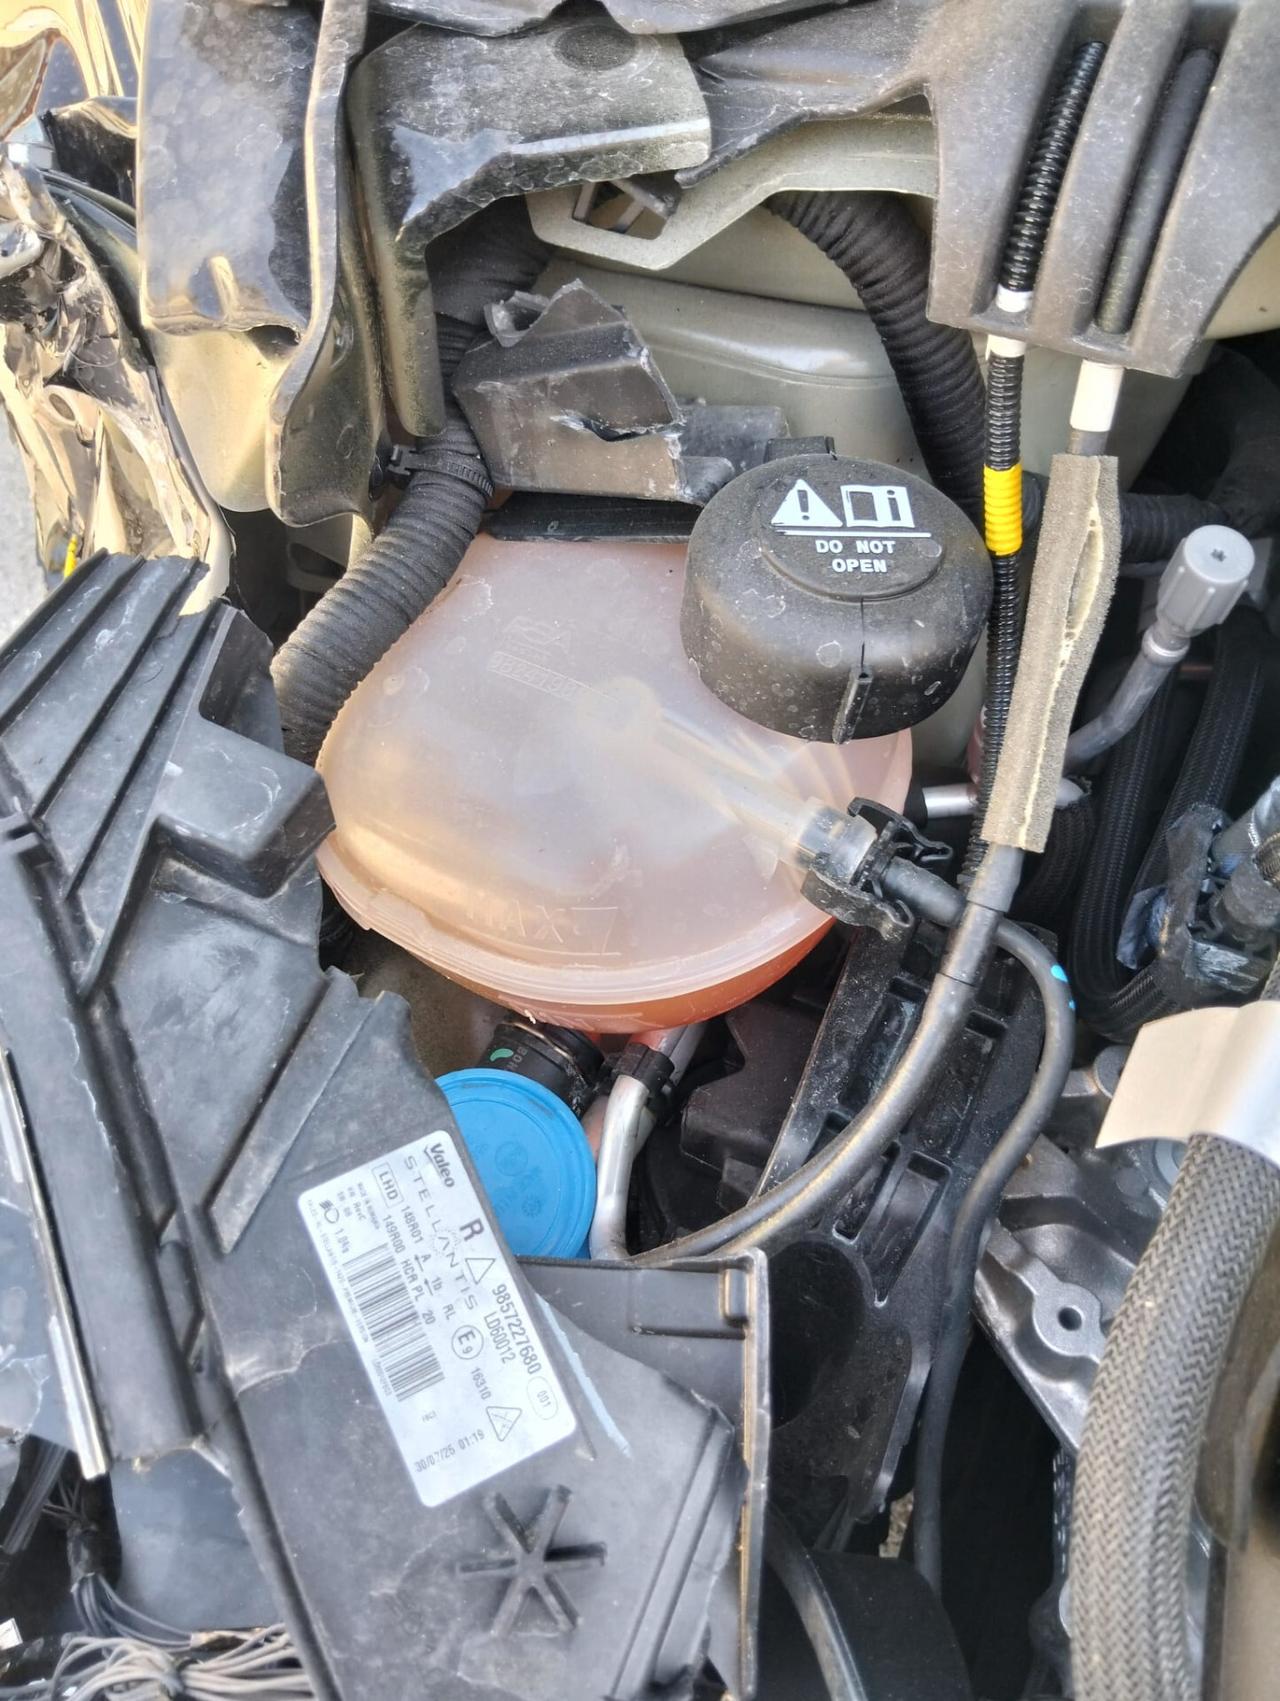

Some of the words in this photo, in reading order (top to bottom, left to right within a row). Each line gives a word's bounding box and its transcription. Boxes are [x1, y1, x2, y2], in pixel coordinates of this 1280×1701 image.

[816, 540, 842, 553] DO
[856, 540, 896, 553] NOT
[832, 558, 887, 572] OPEN
[428, 1141, 458, 1189] Valeo
[377, 1170, 399, 1201] LHD
[402, 1154, 478, 1311] STELLANTIS
[458, 1217, 486, 1241] R
[380, 1214, 406, 1254] 149R00
[399, 1258, 418, 1284] HCR
[410, 1284, 426, 1302] PL
[420, 1309, 436, 1325] 20
[399, 1204, 425, 1244] 148R01
[420, 1252, 432, 1262] A
[441, 1303, 457, 1320] RL
[482, 1311, 517, 1364] LD60012
[490, 1283, 543, 1375] 9857227680
[469, 1367, 492, 1400] 16310
[455, 1427, 486, 1450] 01:19
